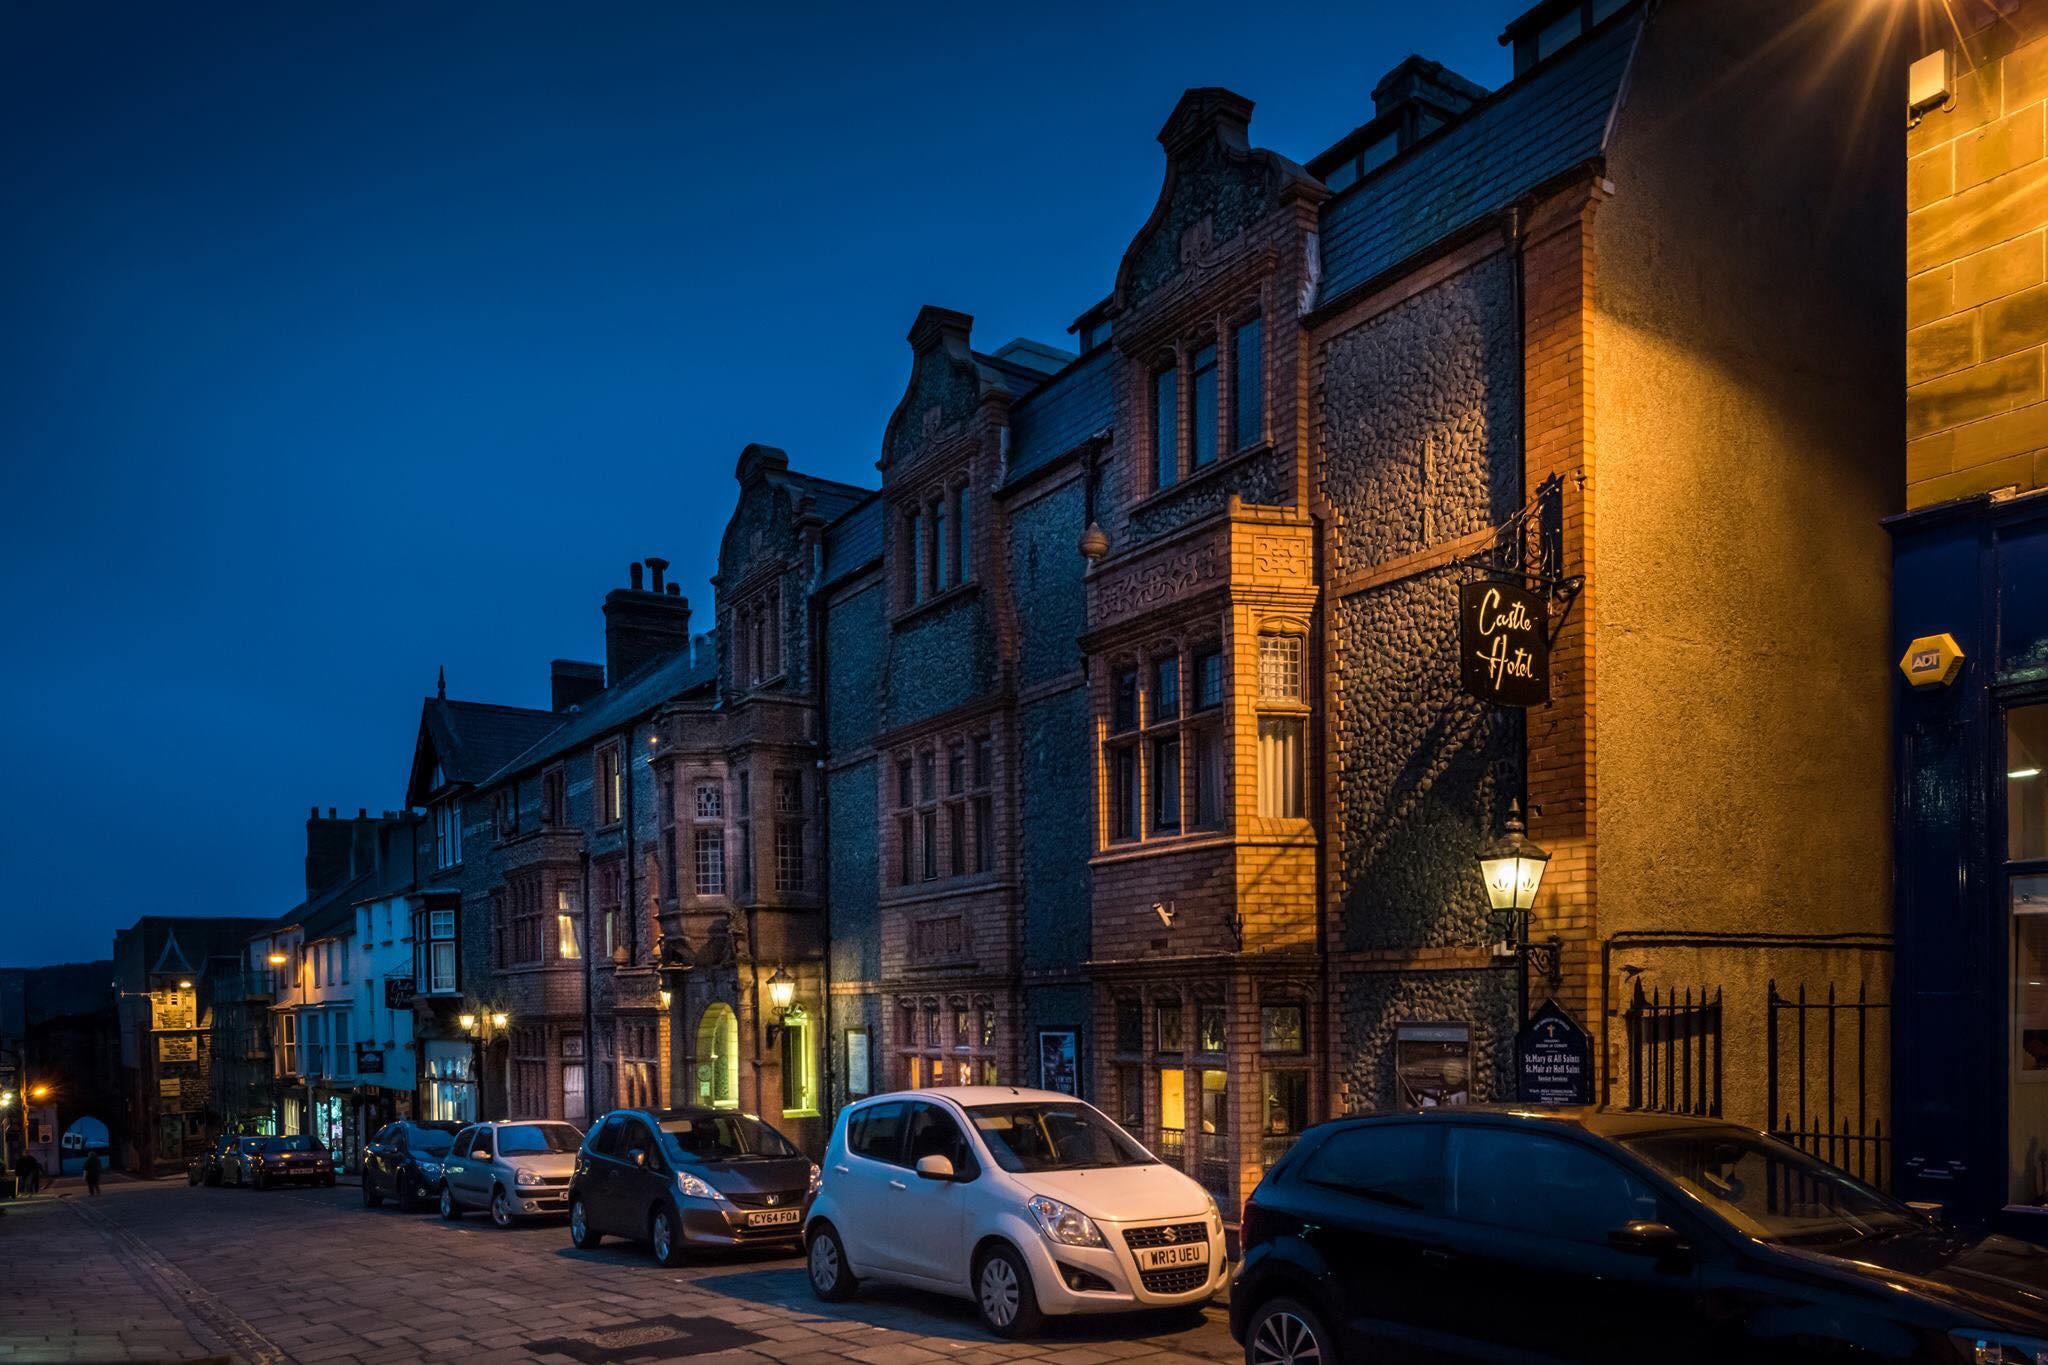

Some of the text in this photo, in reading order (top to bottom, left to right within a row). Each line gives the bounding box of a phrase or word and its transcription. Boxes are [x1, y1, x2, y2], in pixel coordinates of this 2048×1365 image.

[1480, 588, 1532, 635] Castle
[1476, 634, 1533, 690] Hotel
[1912, 653, 1940, 670] ADT
[1547, 1055, 1553, 1063] &
[1554, 1054, 1562, 1063] All
[1563, 1054, 1580, 1063] Saints
[754, 1213, 778, 1224] CY64
[1151, 1247, 1200, 1265] WR13 UEU
